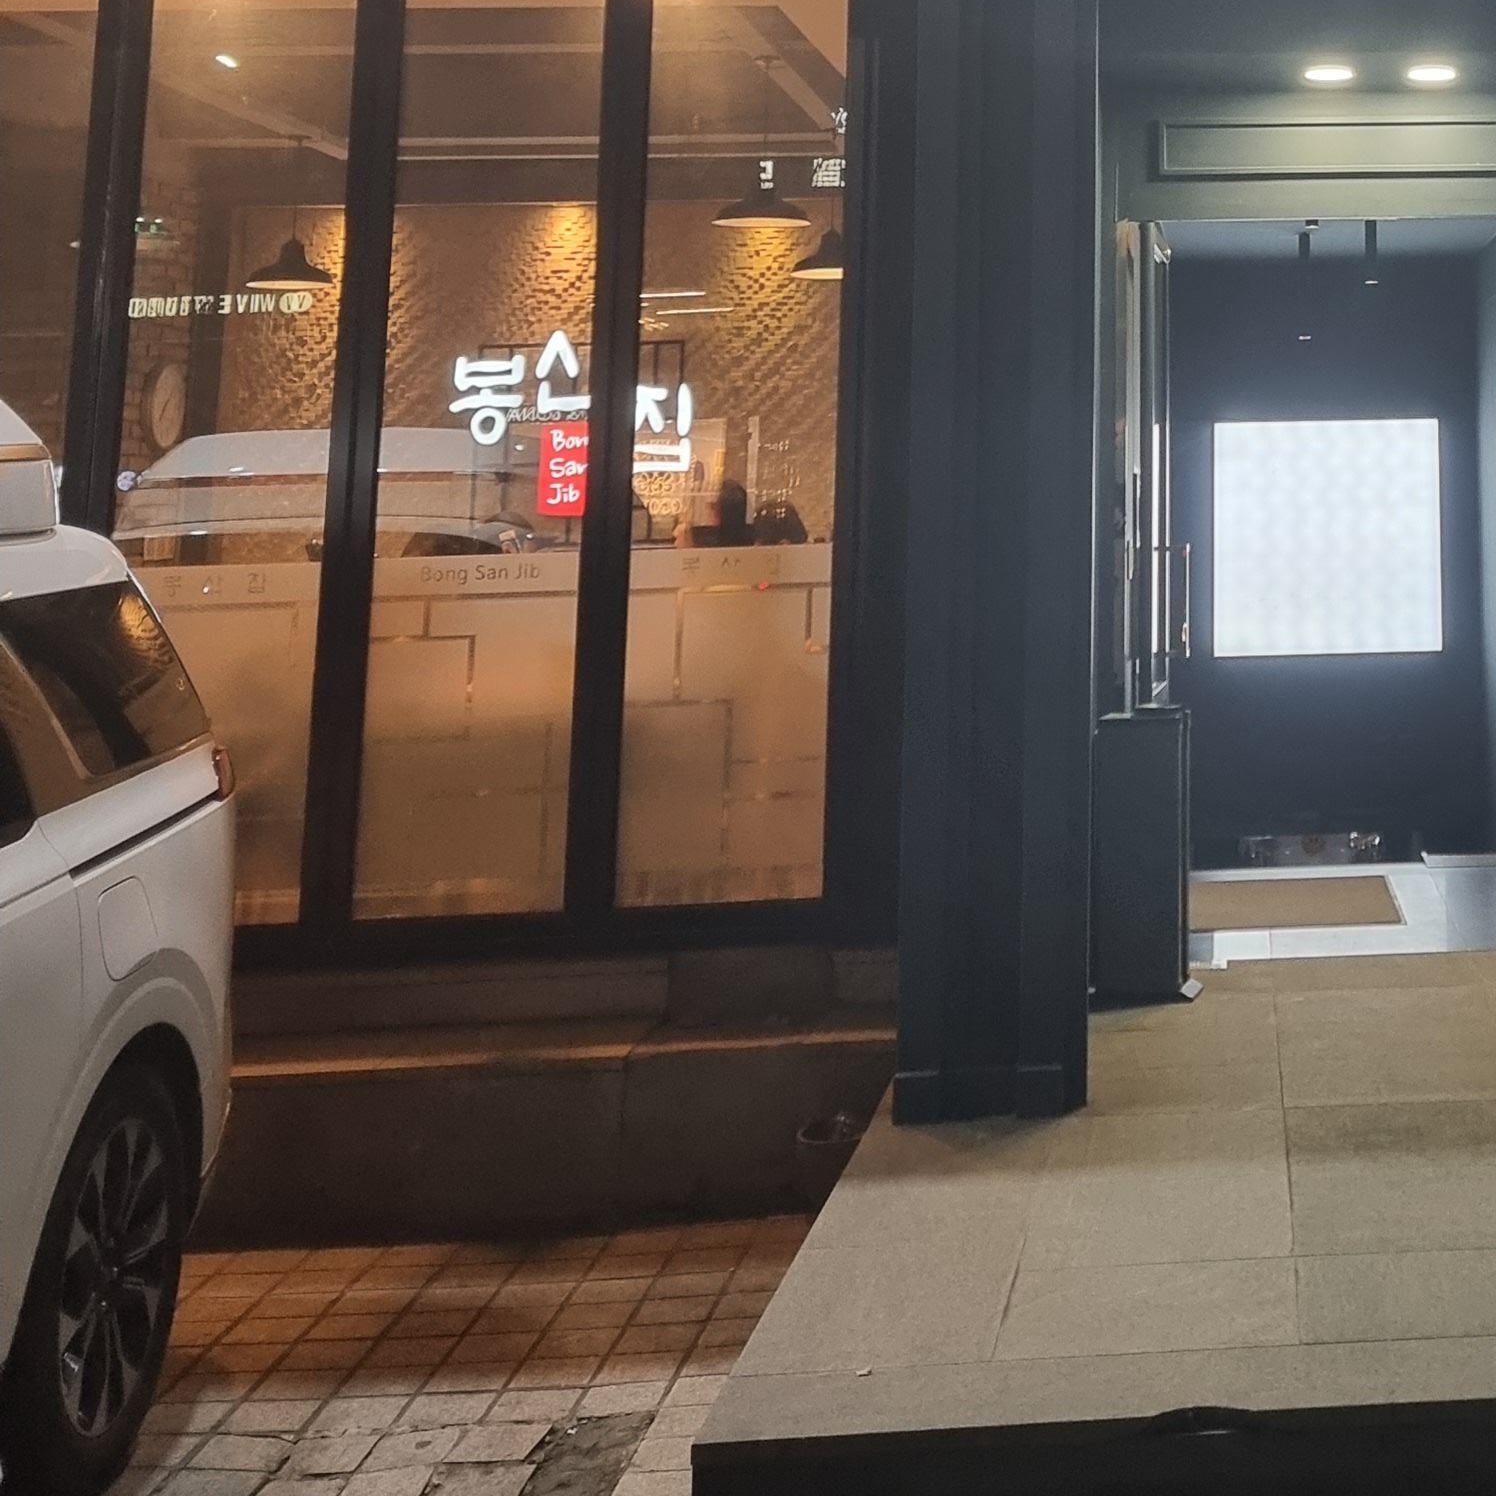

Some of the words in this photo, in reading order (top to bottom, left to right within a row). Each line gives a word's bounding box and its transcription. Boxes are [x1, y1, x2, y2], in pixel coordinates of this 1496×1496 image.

[549, 428, 589, 453] Bon
[546, 482, 581, 506] Jib
[421, 566, 468, 585] Bong
[474, 564, 509, 581] San
[514, 562, 541, 579] Jib
